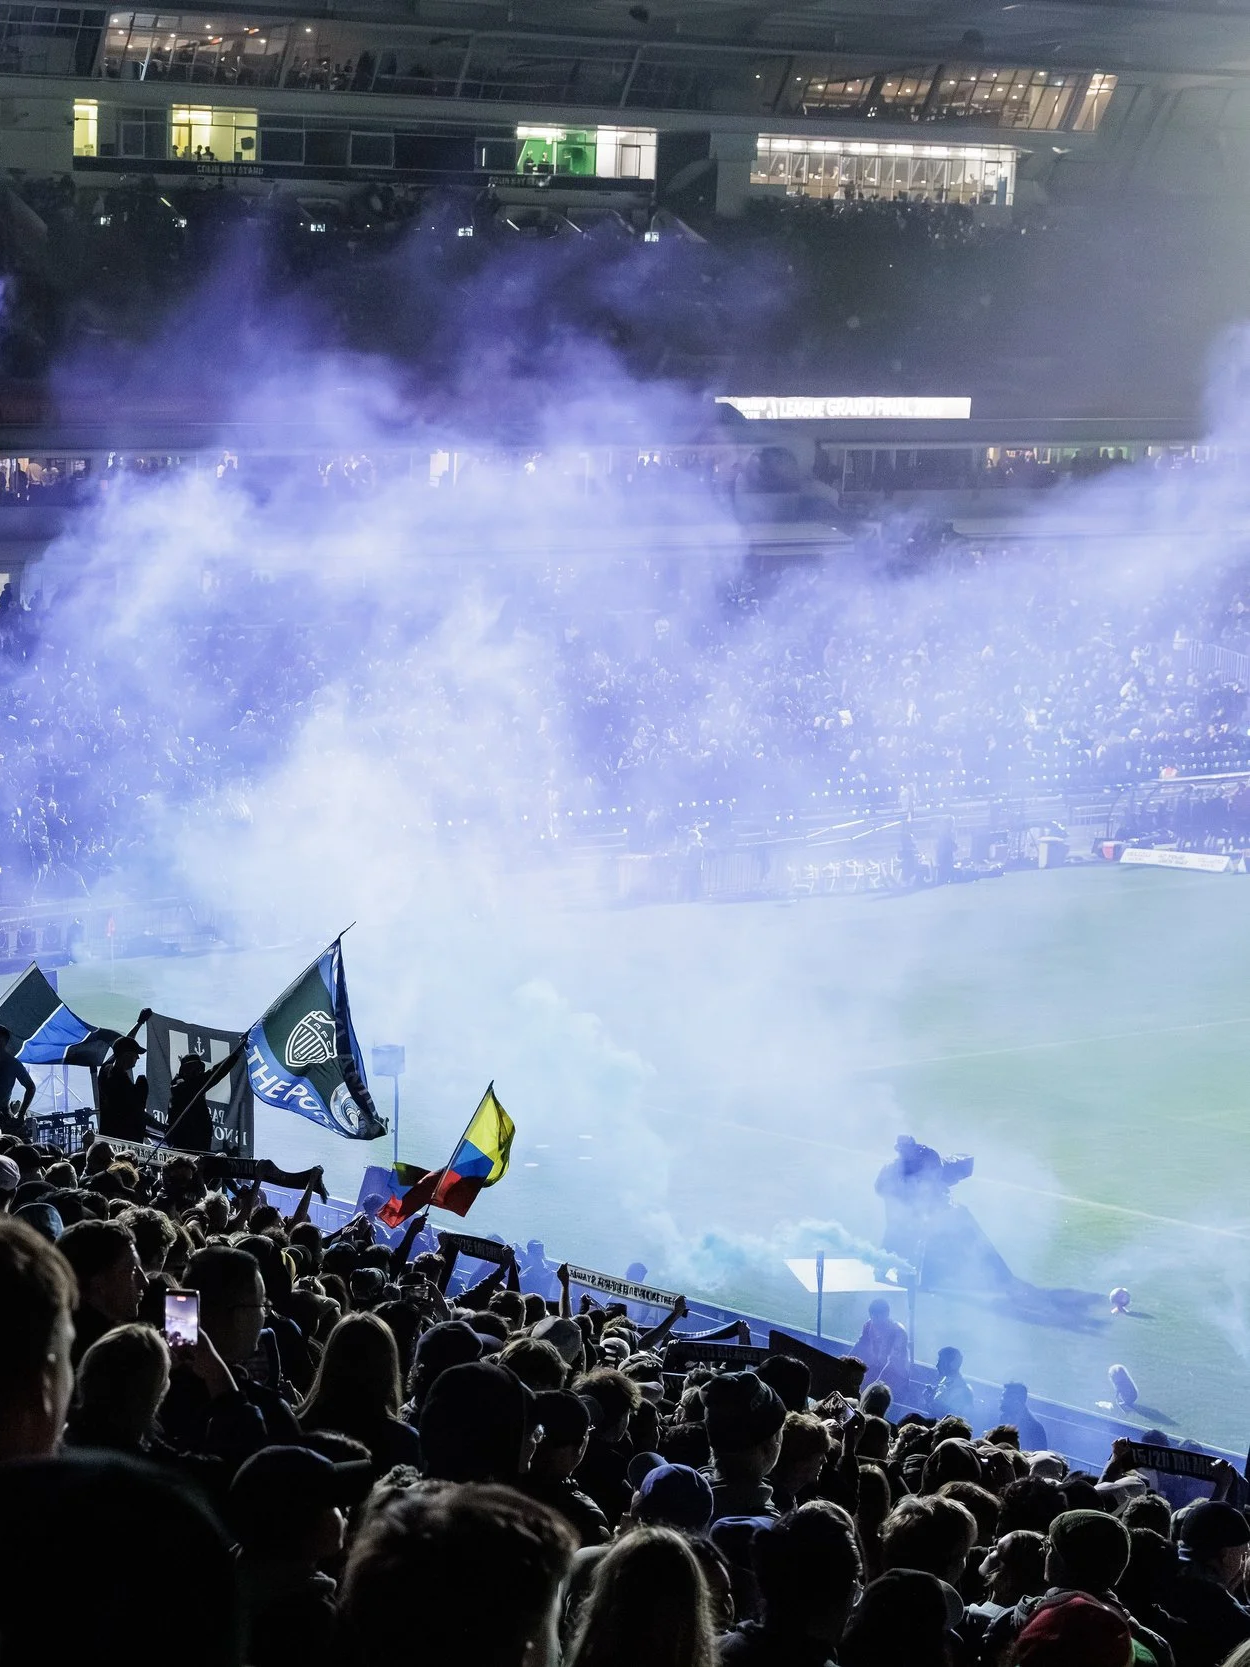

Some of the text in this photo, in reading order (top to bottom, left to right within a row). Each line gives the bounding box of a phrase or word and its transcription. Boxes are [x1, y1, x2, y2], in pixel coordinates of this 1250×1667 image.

[238, 166, 264, 175] STAND
[780, 400, 824, 416] LEAGUE
[826, 400, 873, 416] GRAND
[875, 400, 910, 416] FINAL
[246, 1045, 292, 1099] THE
